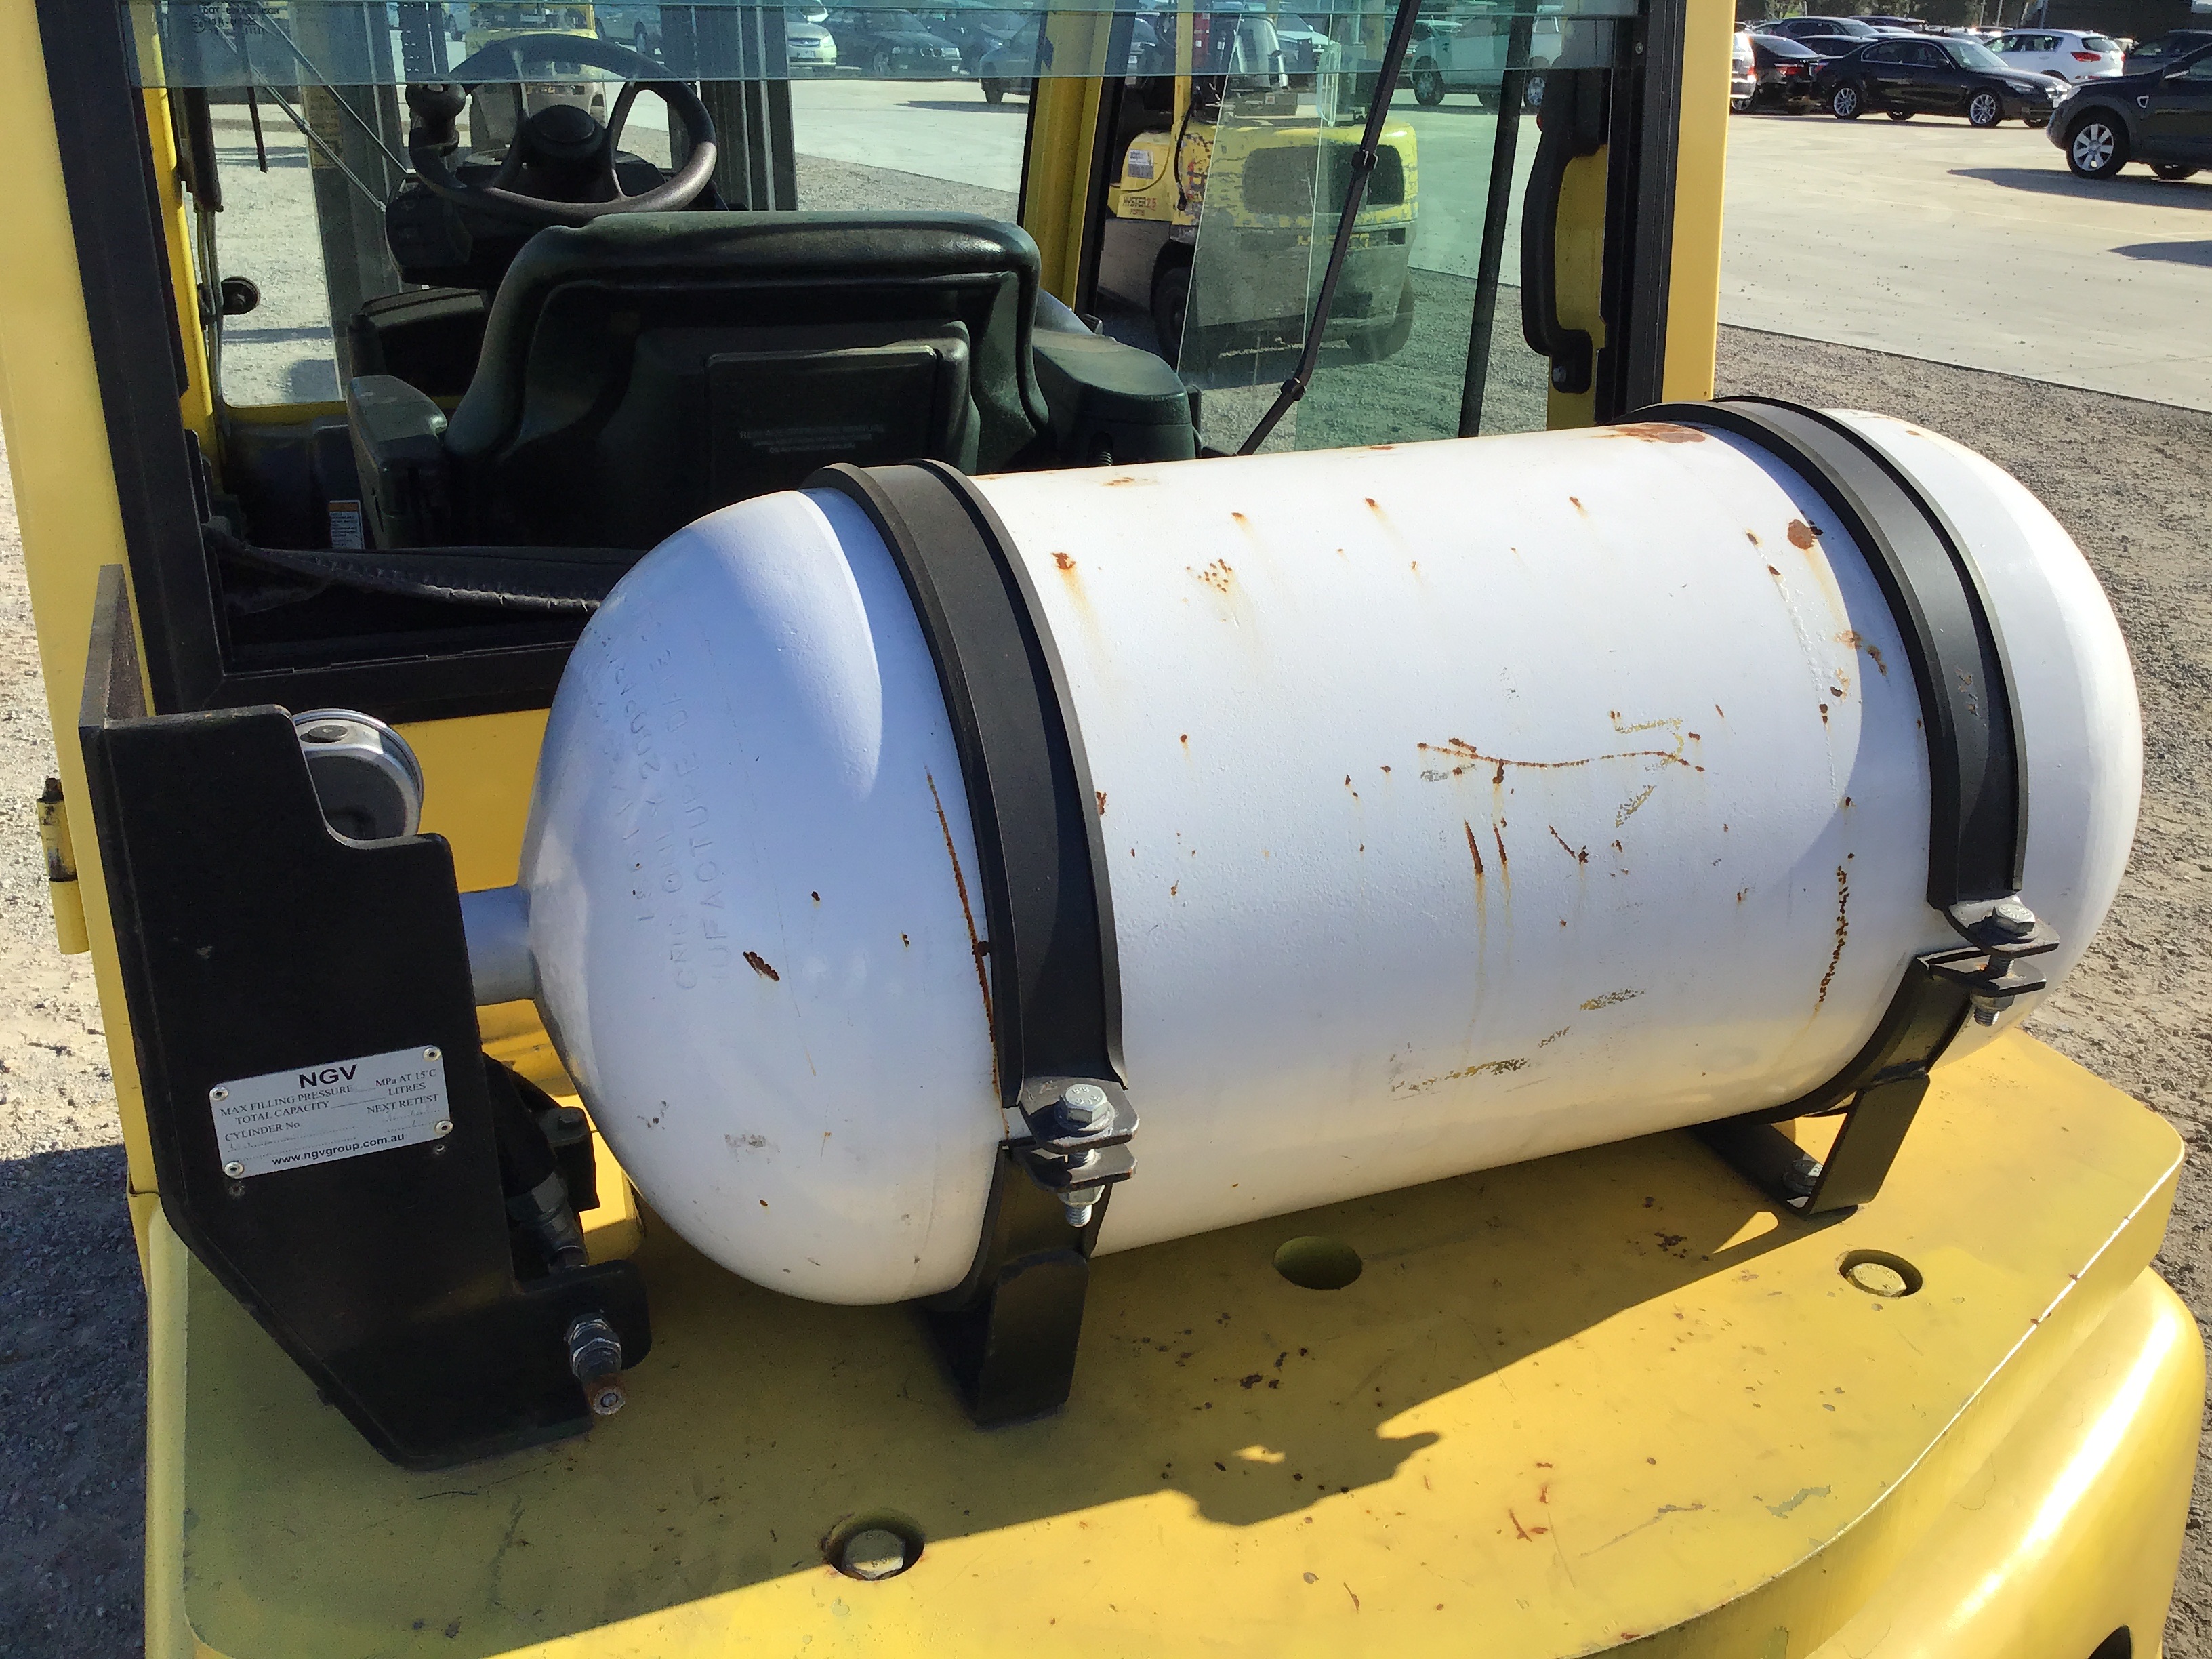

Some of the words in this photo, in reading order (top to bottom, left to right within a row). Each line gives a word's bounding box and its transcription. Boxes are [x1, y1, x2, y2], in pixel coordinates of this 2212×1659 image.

[220, 1105, 247, 1117] MAX
[251, 1096, 295, 1111] FILLING
[298, 1085, 352, 1101] PRESSURE
[375, 1077, 396, 1087] MPa
[398, 1073, 412, 1084] AT
[299, 1064, 357, 1088] NGV
[225, 1124, 283, 1141] CYLINDER
[367, 1103, 396, 1113] NEXT
[398, 1094, 438, 1108] RETEST
[235, 1111, 272, 1124] TOTAL
[274, 1101, 329, 1118] CAPACITY
[388, 1083, 426, 1095] LITRES
[272, 1133, 405, 1164] www.ngvgroup.com.au
